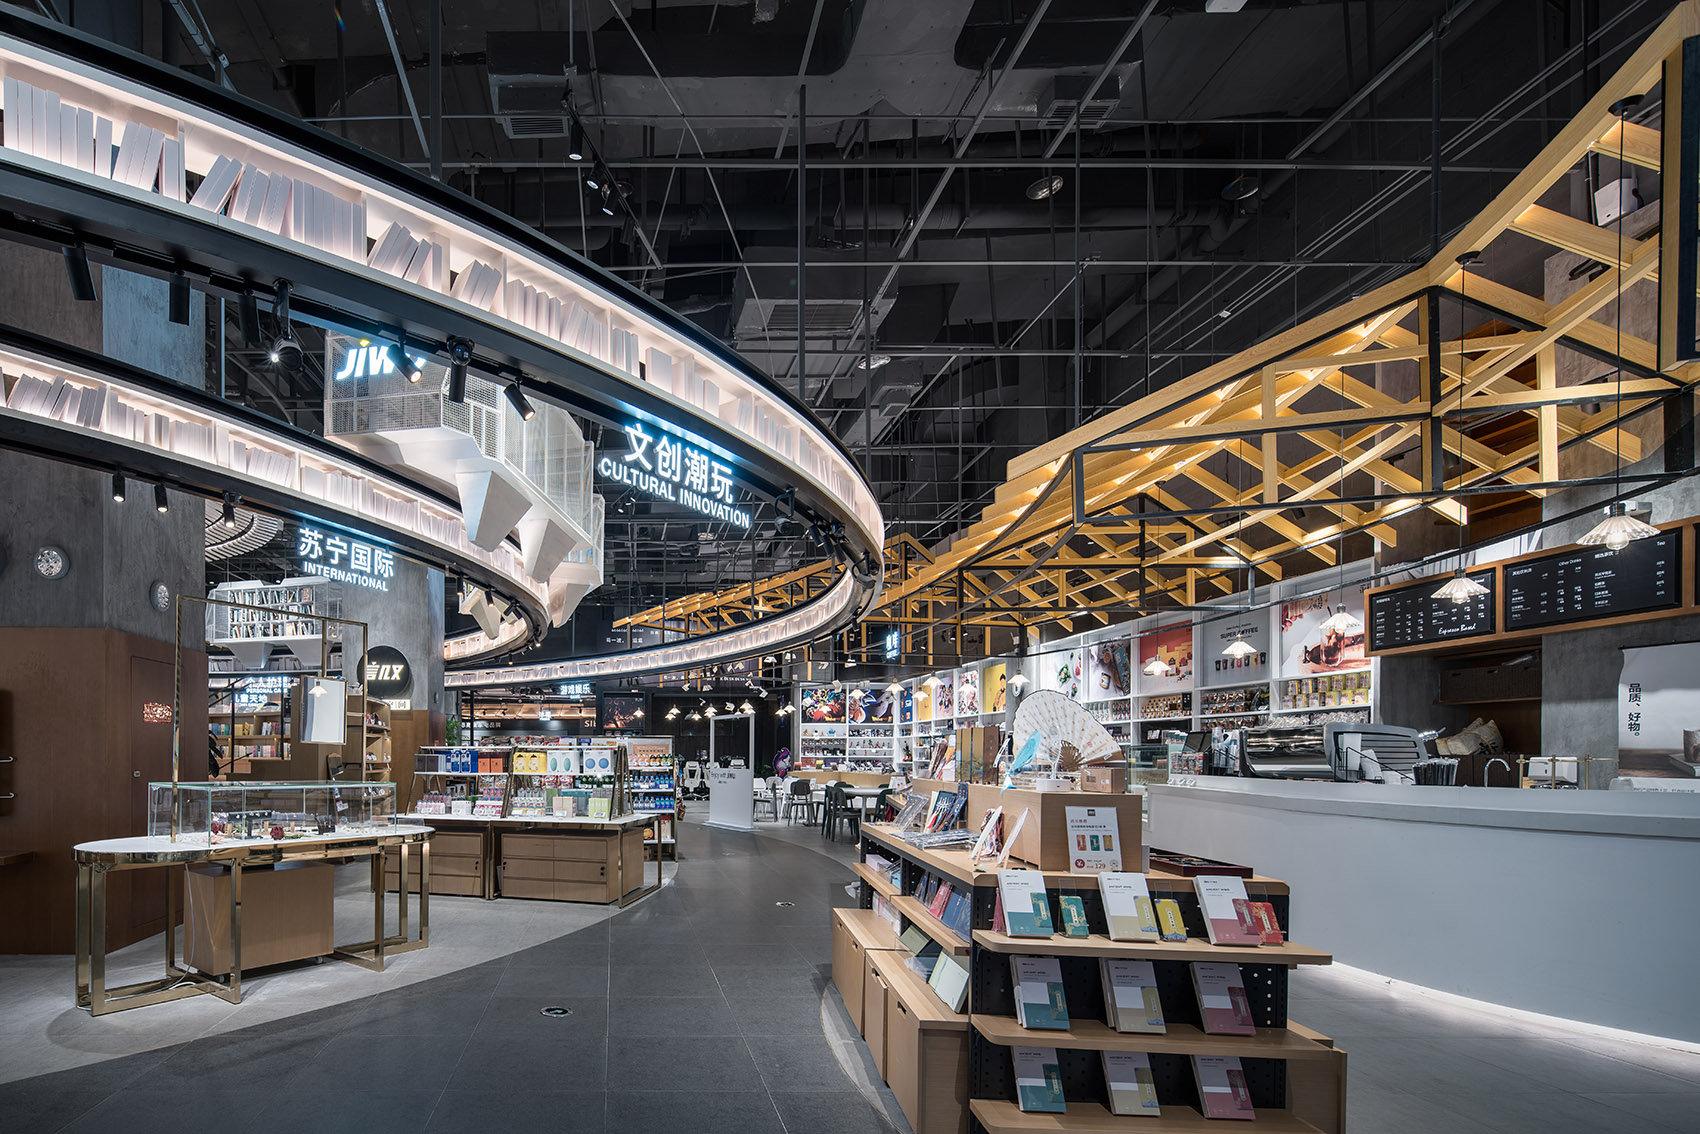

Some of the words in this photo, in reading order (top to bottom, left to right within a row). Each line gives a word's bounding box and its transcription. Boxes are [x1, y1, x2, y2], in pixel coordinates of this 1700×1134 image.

[624, 423, 733, 504] 文创潮玩
[600, 457, 676, 501] CULTURAL
[679, 487, 750, 529] INNOVATION
[299, 527, 394, 578] 苏宁国际
[304, 561, 389, 592] INTERNATIONAL
[367, 661, 405, 680] 言几又
[560, 683, 592, 695] 游戏娱乐
[1627, 683, 1641, 736] 品质、好物。
[1095, 862, 1106, 870] 129
